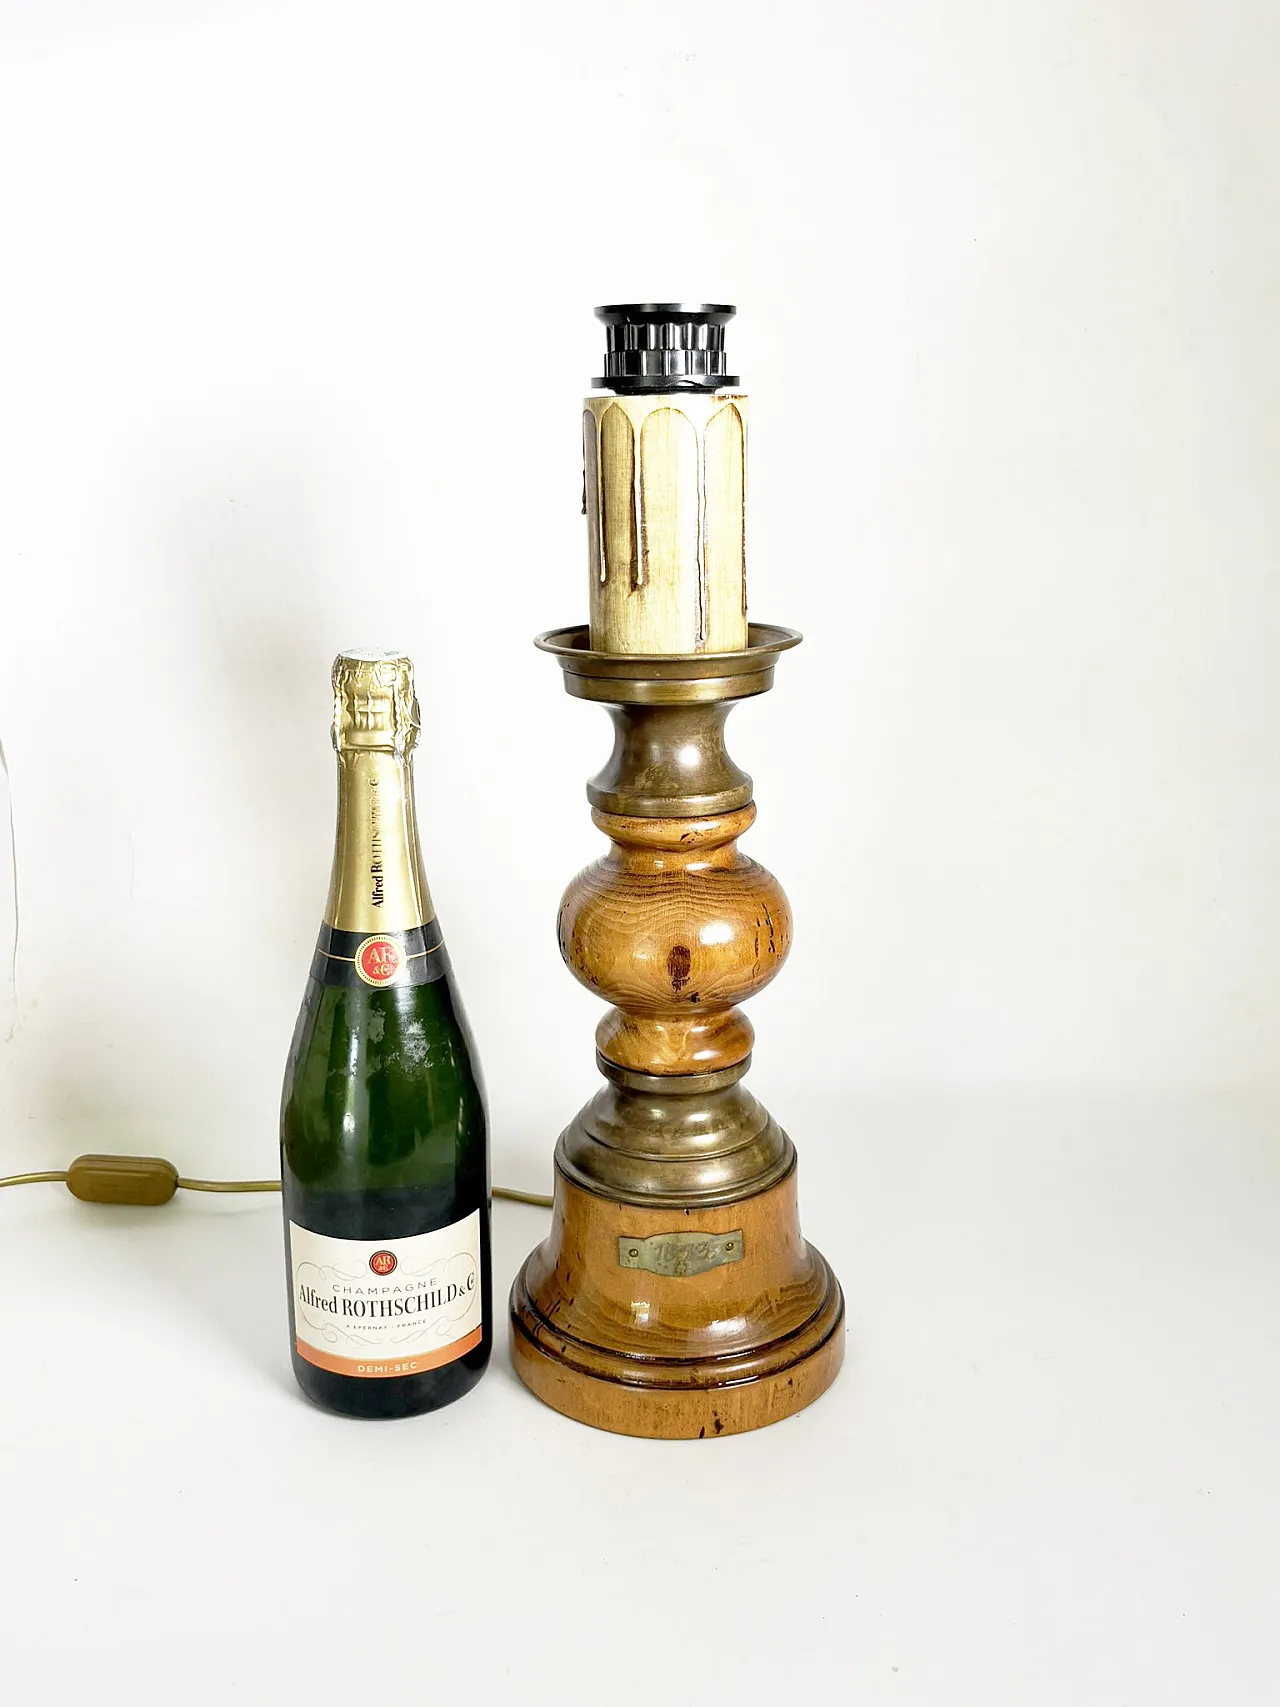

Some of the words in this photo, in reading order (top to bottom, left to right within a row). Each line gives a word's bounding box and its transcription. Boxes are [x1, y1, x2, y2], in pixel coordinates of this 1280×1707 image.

[370, 796, 383, 874] ROTHSD
[371, 876, 384, 908] Alfred
[375, 1255, 392, 1265] AR
[332, 1277, 437, 1295] CHAMPAGNE
[299, 1284, 338, 1314] Alfred
[341, 1283, 457, 1318] ROTHSCHILD
[396, 1319, 427, 1329] FRANCE
[357, 1361, 418, 1373] DEMI-SEC
